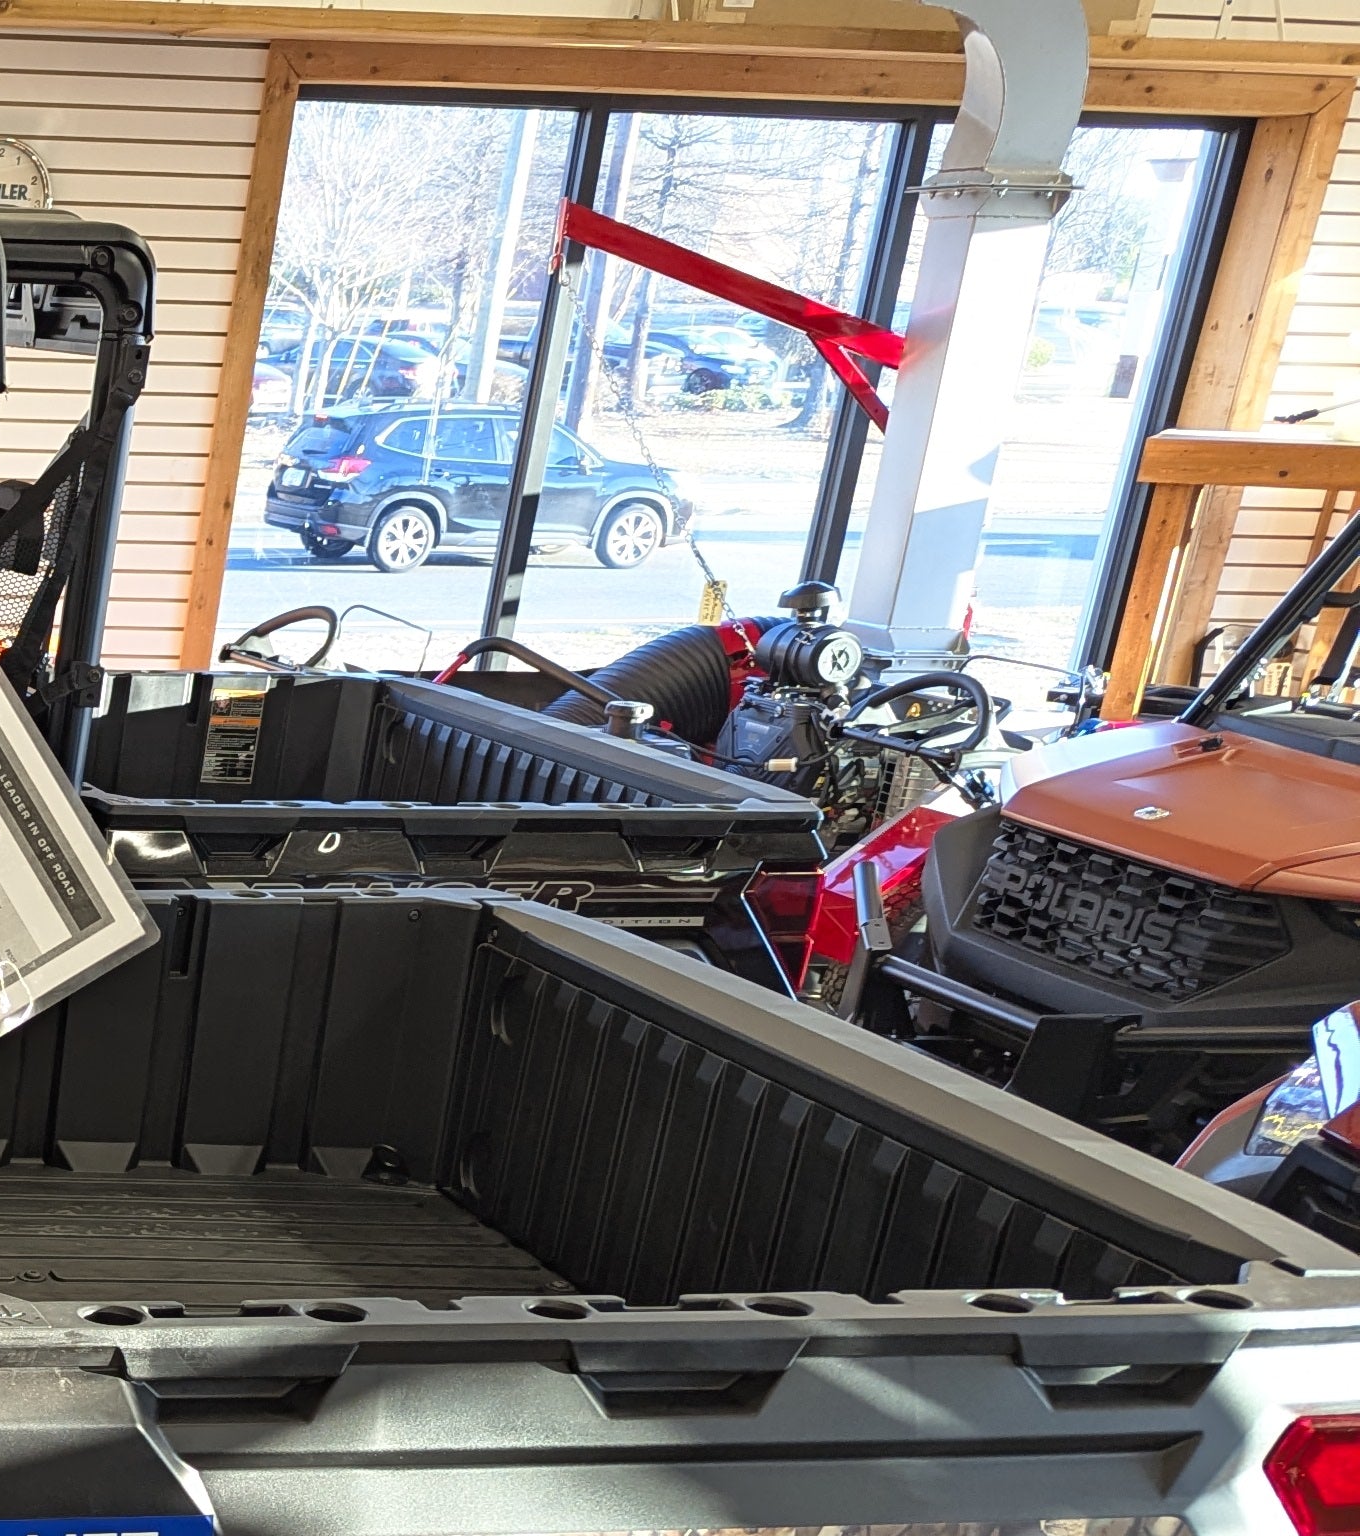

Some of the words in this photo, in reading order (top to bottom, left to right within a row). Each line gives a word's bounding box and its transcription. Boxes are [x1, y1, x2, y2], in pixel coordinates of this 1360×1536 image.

[16, 156, 21, 166] 1
[31, 176, 38, 186] 2
[26, 820, 40, 836] IN
[36, 836, 56, 862] OFF
[51, 862, 78, 900] ROAD.
[990, 865, 1179, 952] POLARIS
